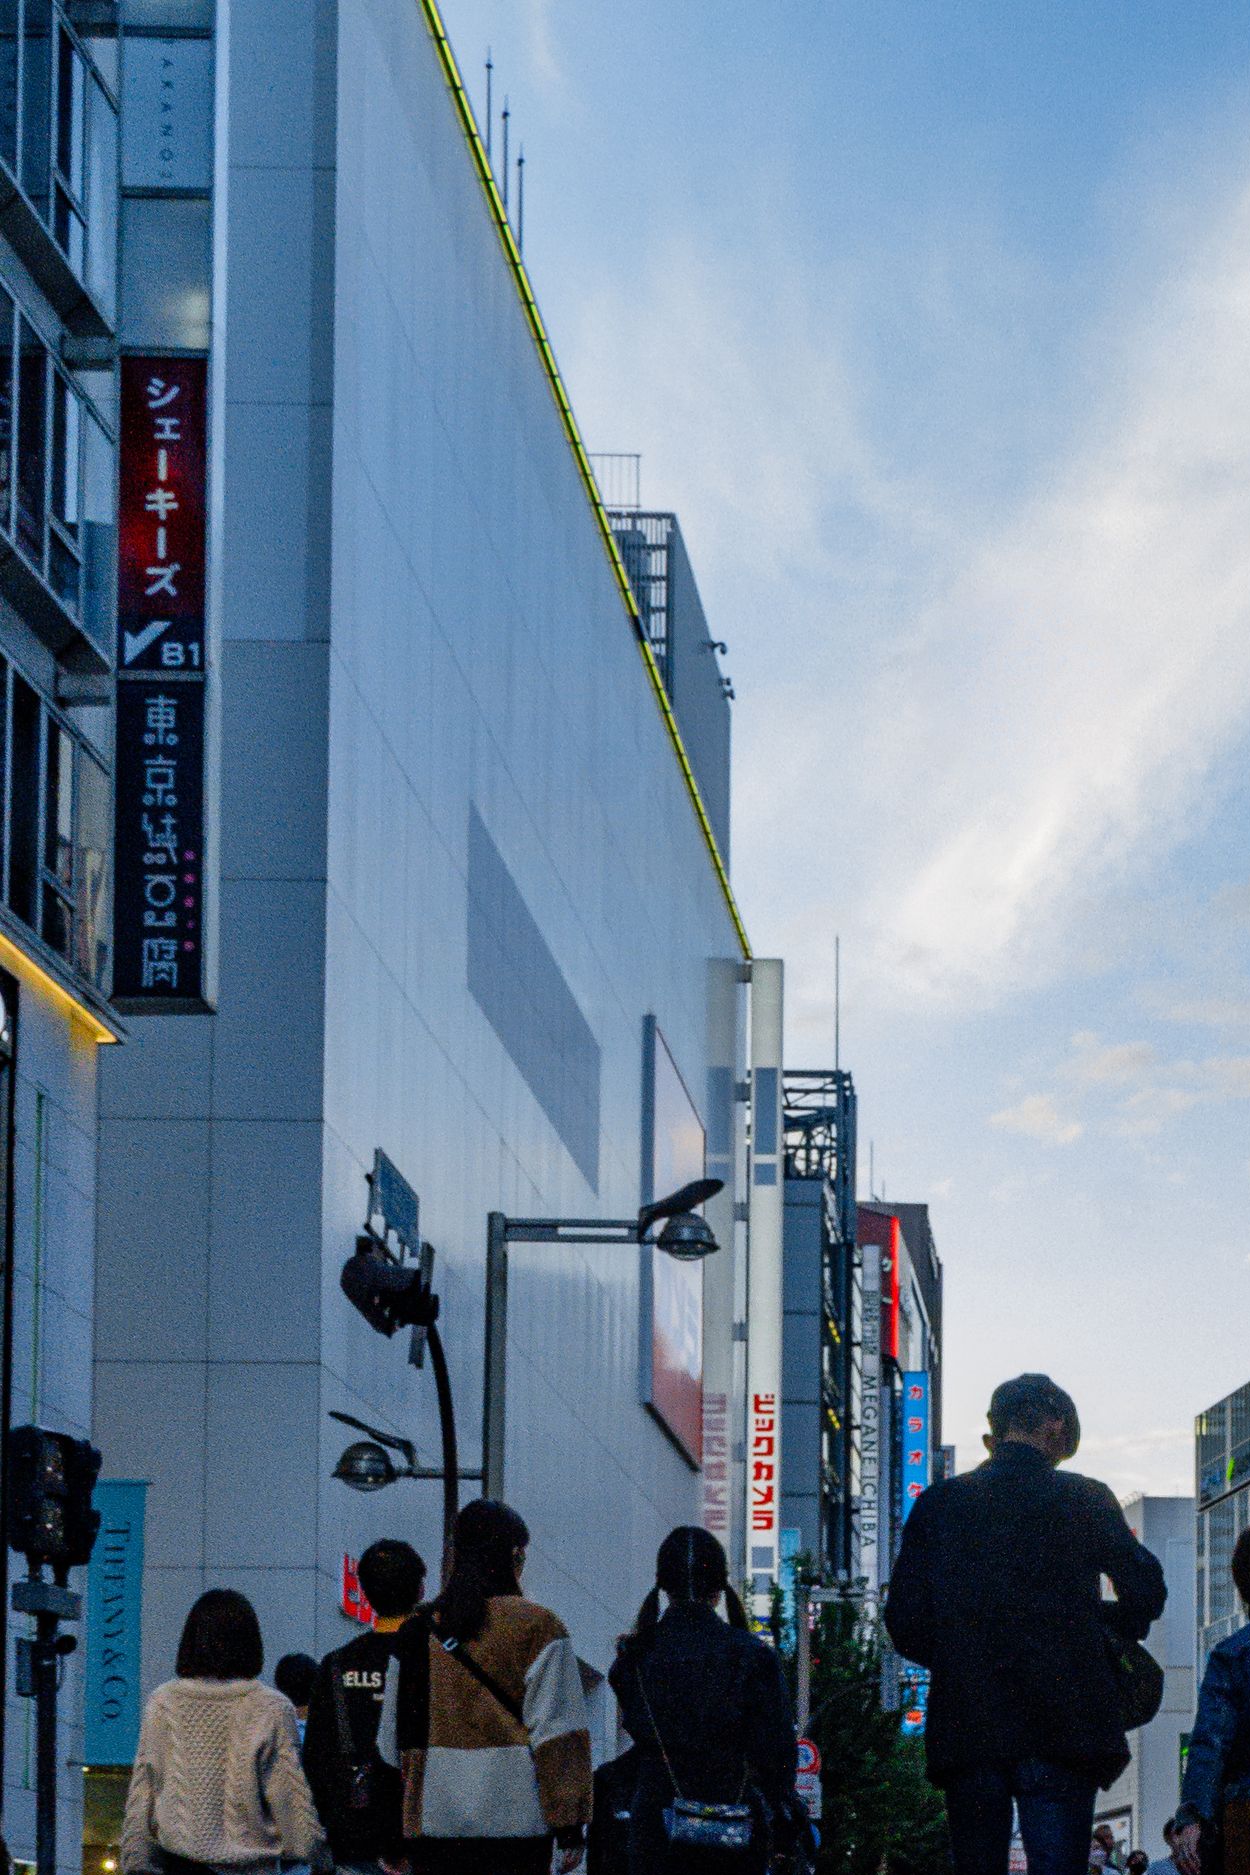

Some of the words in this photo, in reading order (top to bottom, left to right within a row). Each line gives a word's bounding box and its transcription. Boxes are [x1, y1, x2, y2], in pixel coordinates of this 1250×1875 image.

[145, 375, 180, 600] シェーキーズ
[161, 643, 200, 666] B1
[862, 1374, 880, 1468] MEGANE
[907, 1385, 925, 1500] カラオケ
[861, 1474, 879, 1549] ICHIBA
[104, 1521, 131, 1638] TIFFANY
